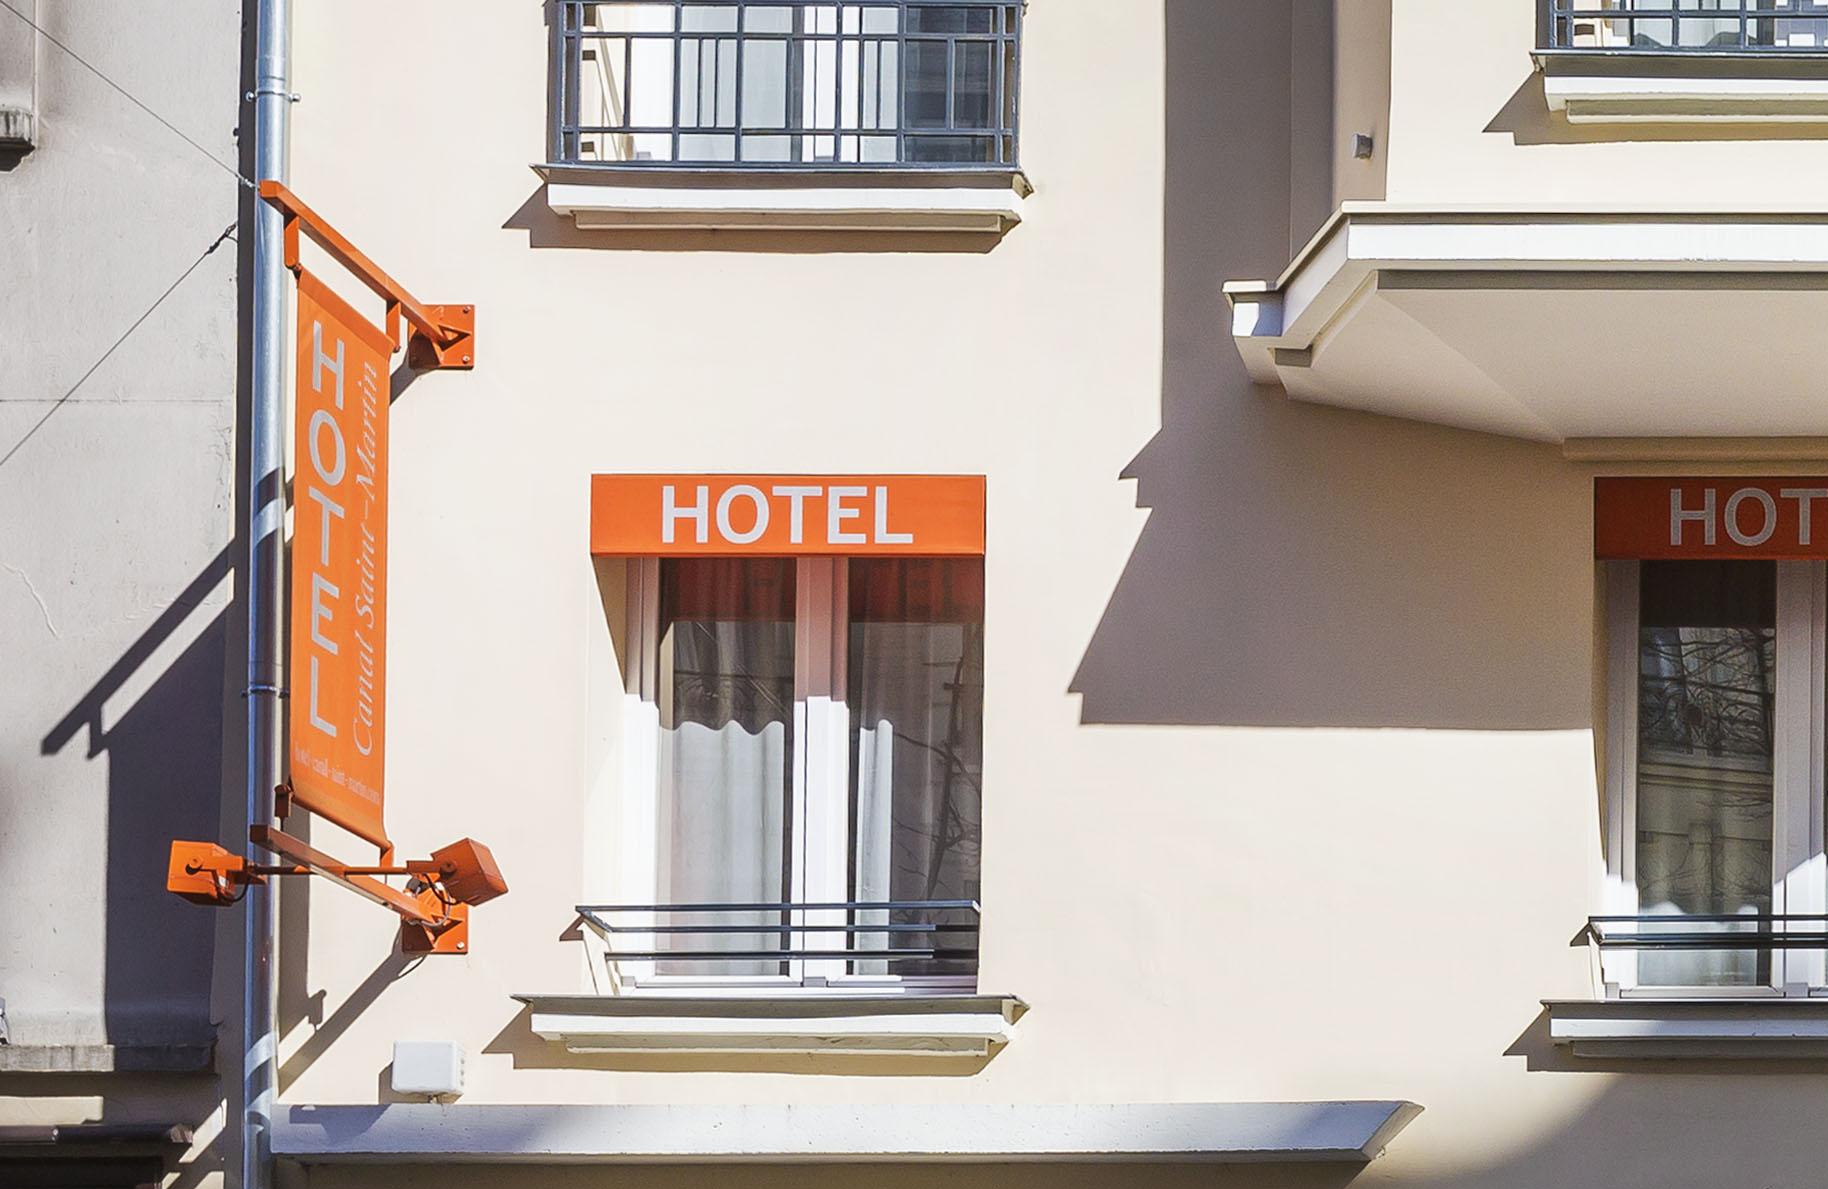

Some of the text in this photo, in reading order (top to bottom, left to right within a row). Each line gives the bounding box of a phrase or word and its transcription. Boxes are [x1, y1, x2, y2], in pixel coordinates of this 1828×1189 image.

[308, 320, 346, 737] HOTEL
[353, 361, 377, 755] Canal Saint-Martin
[662, 484, 913, 544] HOTEL
